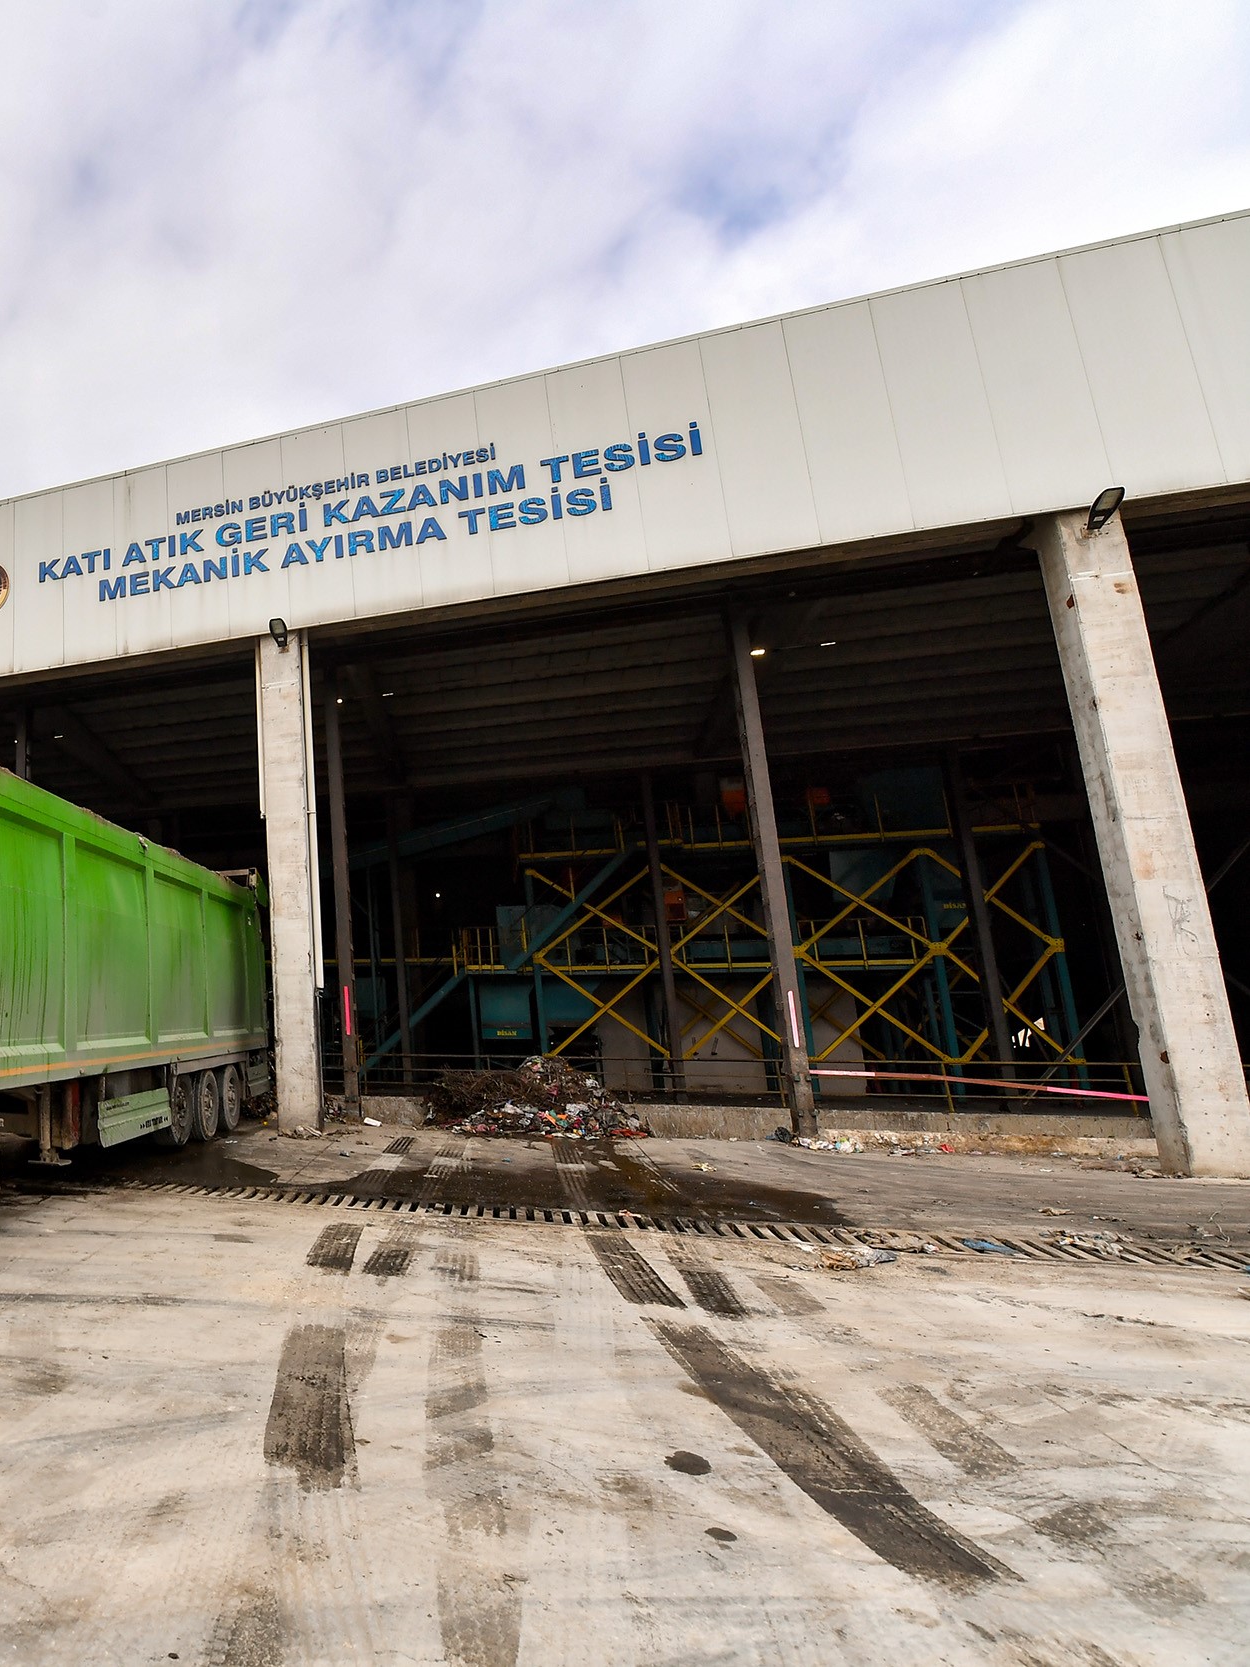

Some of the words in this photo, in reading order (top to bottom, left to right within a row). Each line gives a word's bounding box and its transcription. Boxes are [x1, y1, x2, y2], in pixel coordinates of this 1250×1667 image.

[39, 548, 111, 583] KATI
[122, 529, 204, 568] ATIK
[215, 502, 308, 548] GERİ
[323, 464, 526, 527] KAZANIM
[540, 421, 703, 483] TESİSİ
[99, 548, 270, 602] MEKANİK
[281, 517, 447, 569] AYIRMA
[458, 477, 613, 536] TESİSİ
[176, 499, 243, 526] MERSİN
[249, 472, 370, 510] BÜYÜKŞEHİR
[376, 442, 497, 483] BELEDİYESİ
